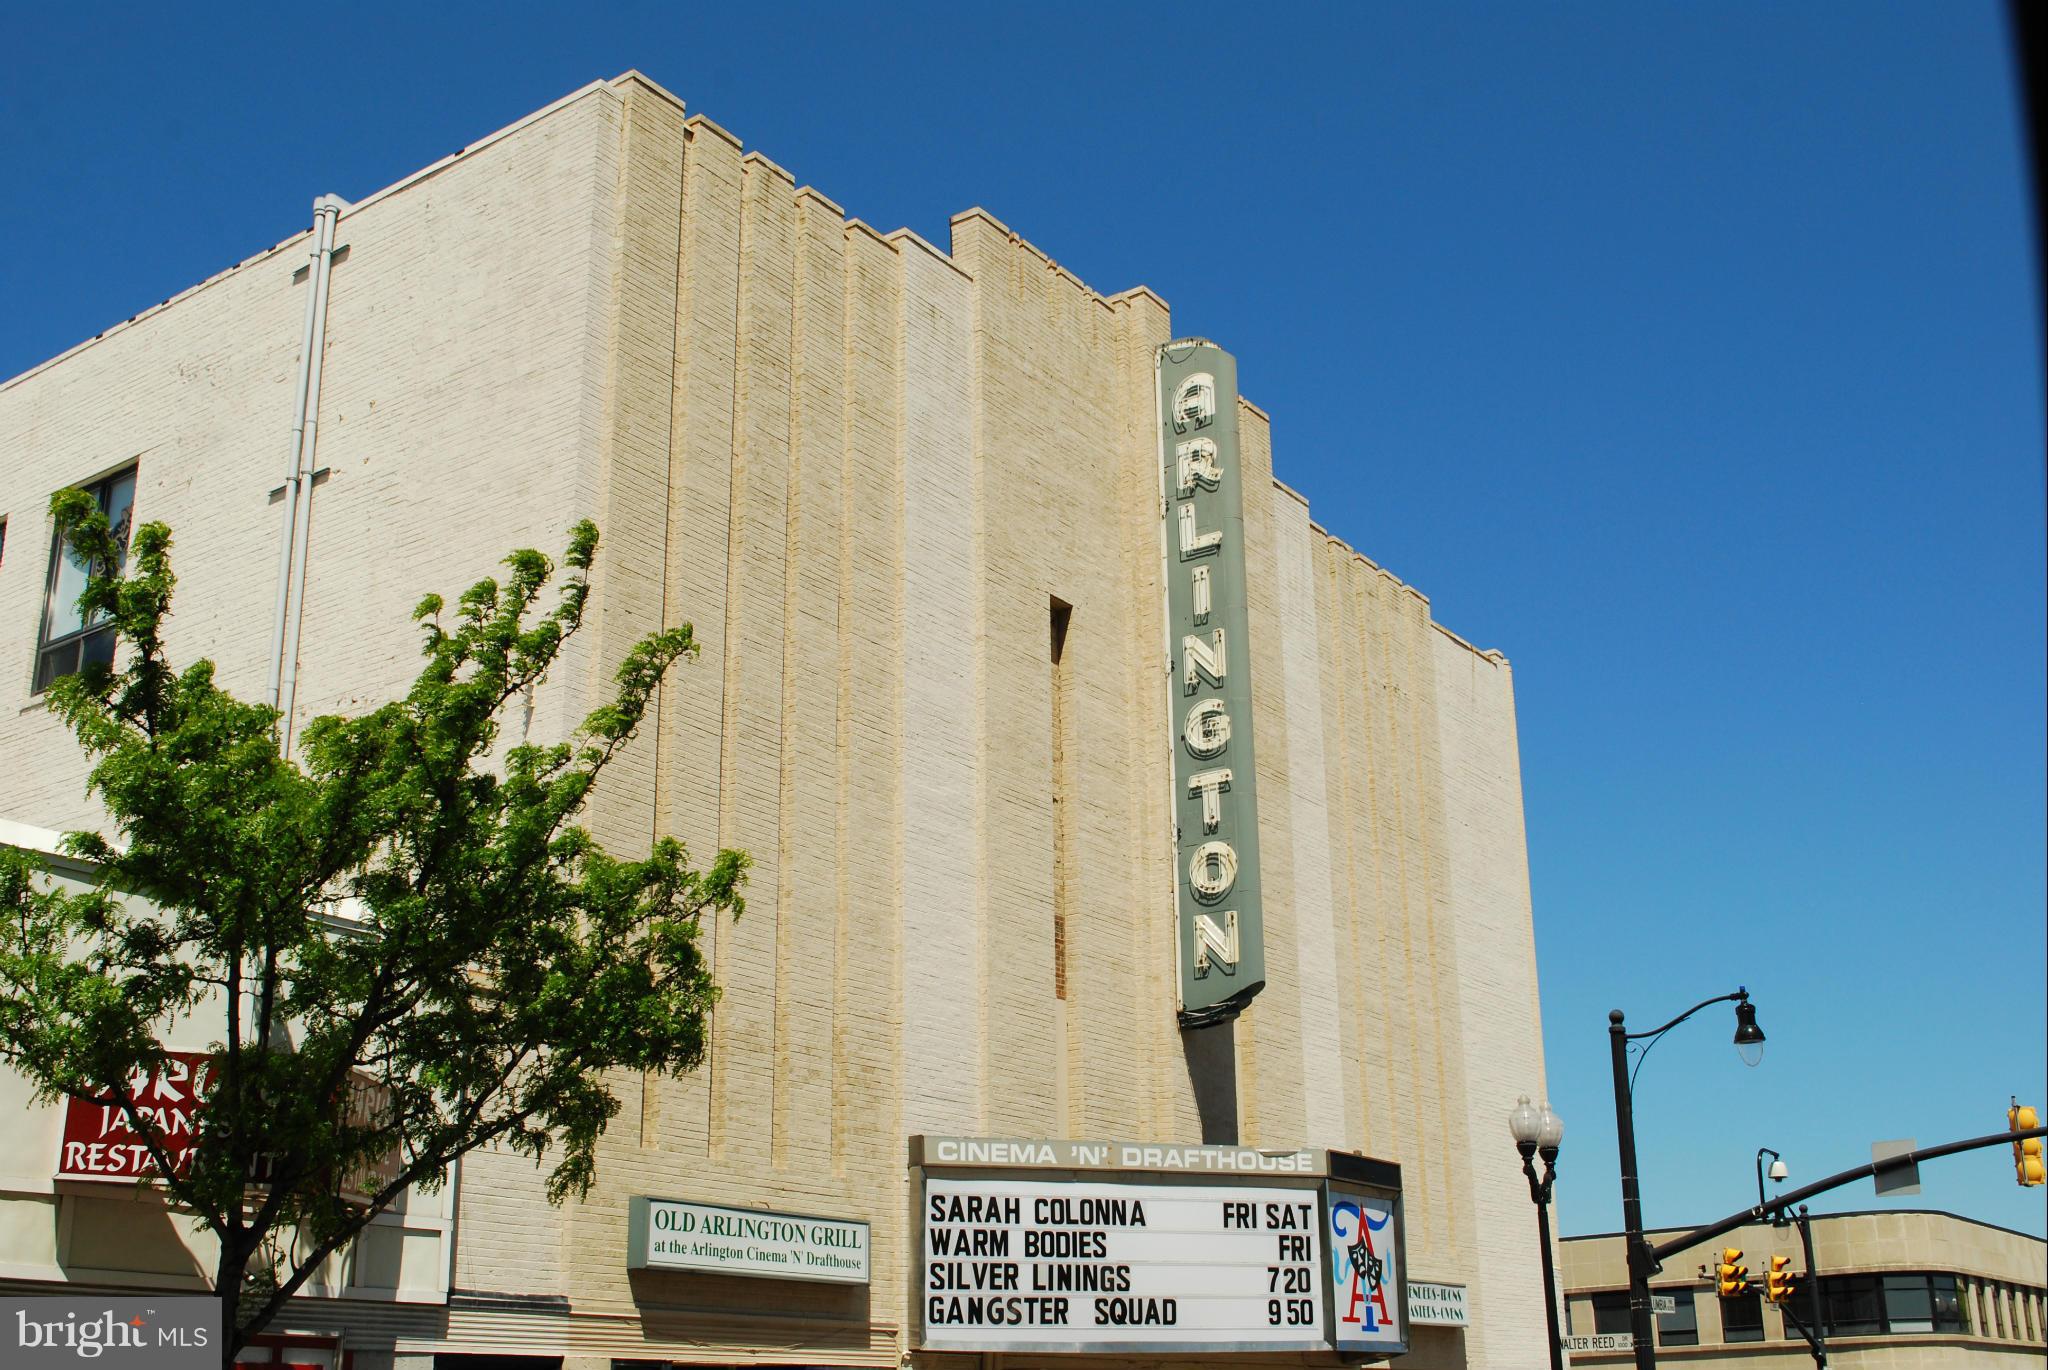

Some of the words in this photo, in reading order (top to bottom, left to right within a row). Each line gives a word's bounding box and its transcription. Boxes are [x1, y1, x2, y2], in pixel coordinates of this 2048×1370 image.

[1172, 372, 1240, 968] ARLINGTON
[937, 1141, 1057, 1164] CINEMA
[1121, 1147, 1313, 1172] DRAFTHOUSE
[930, 1195, 1020, 1225] SARAH
[1034, 1198, 1147, 1227] COLONNA
[1223, 1202, 1257, 1229] FRI
[1266, 1203, 1312, 1230] SAT
[655, 1209, 696, 1233] OLD
[700, 1214, 806, 1244] ARLINGTON
[811, 1225, 862, 1249] GRILL
[654, 1240, 666, 1252] at
[669, 1240, 688, 1254] the
[691, 1242, 744, 1261] Arlington
[746, 1246, 788, 1263] Cinema
[806, 1252, 862, 1270] Drafthouse
[930, 1228, 1009, 1257] WARM
[1024, 1230, 1107, 1258] BODIES
[1279, 1234, 1312, 1262] FRI
[930, 1262, 1019, 1290] SILVER
[1032, 1263, 1131, 1292] LININGS
[928, 1296, 1069, 1325] GANGSTER
[1094, 1297, 1177, 1326] SQUAD
[1592, 1337, 1615, 1349] REED
